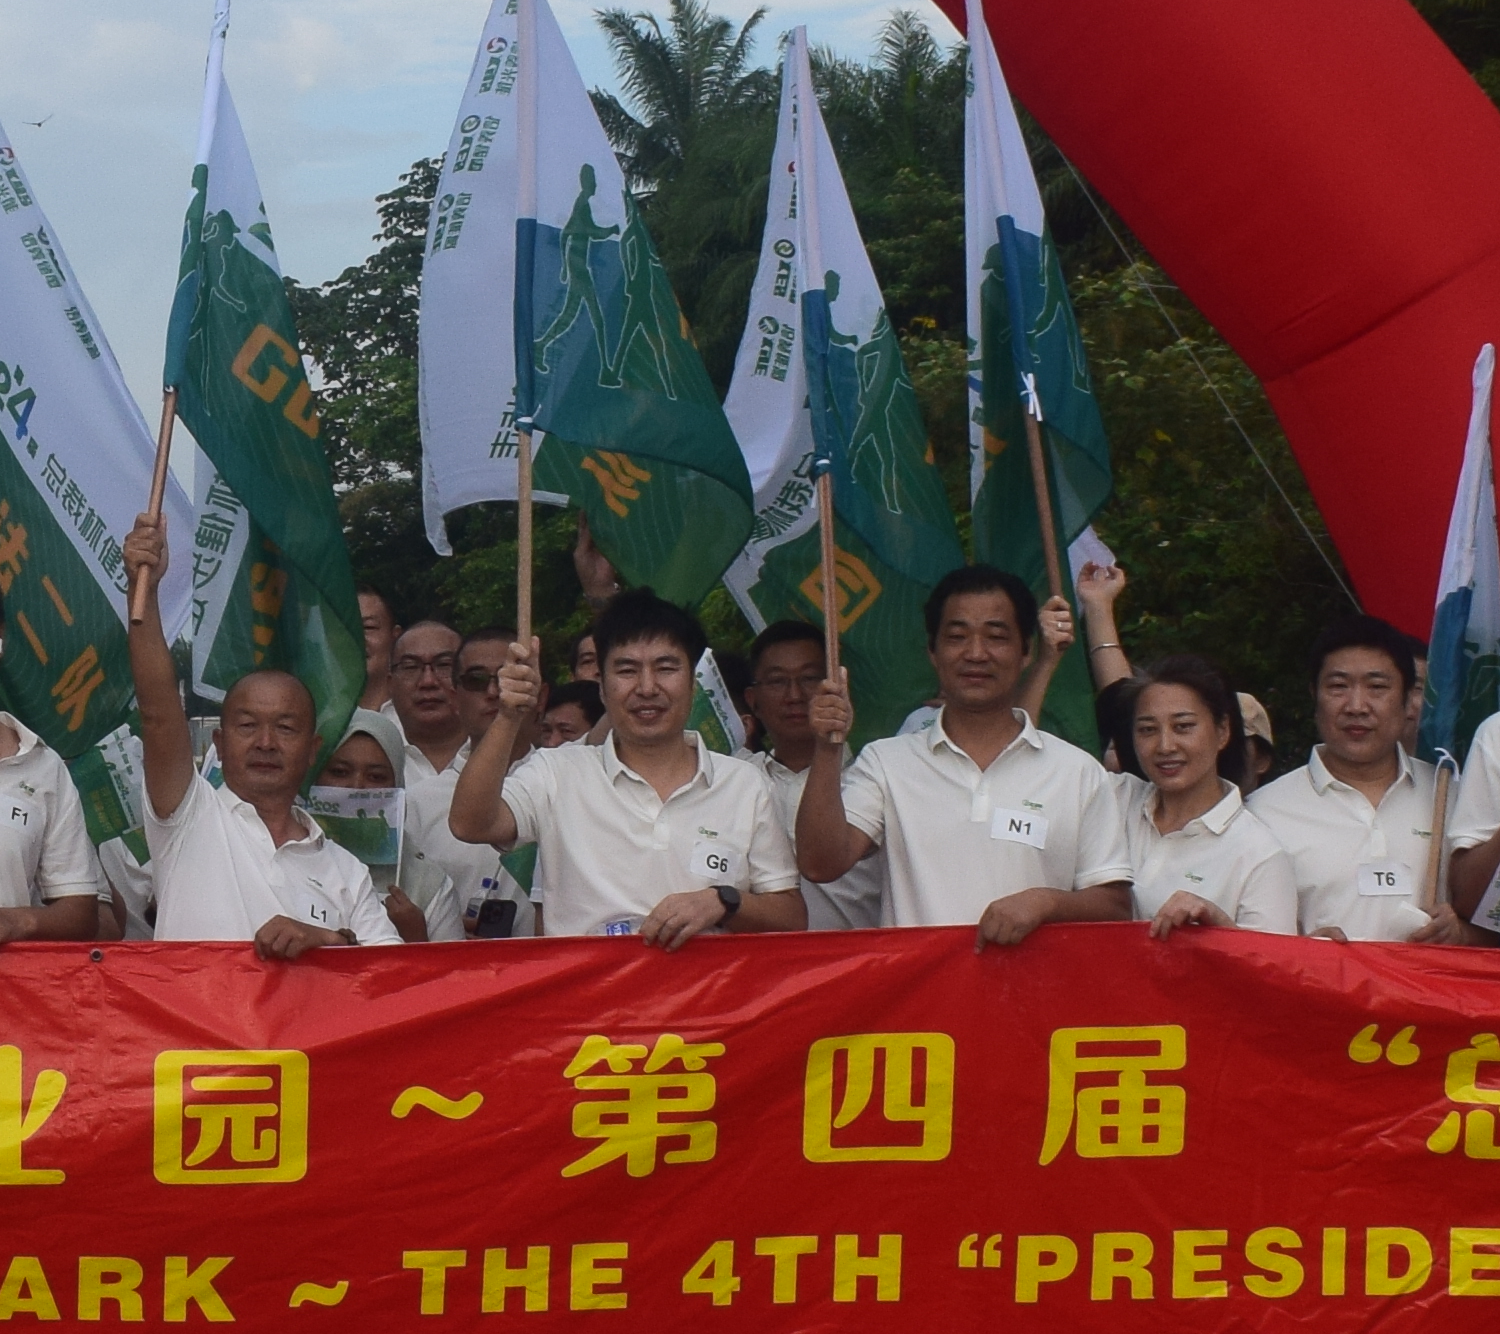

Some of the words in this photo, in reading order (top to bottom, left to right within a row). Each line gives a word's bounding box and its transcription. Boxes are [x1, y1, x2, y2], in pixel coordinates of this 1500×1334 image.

[10, 807, 29, 826] F1
[1008, 818, 1032, 836] N1
[705, 854, 728, 872] G6
[1373, 870, 1396, 886] T6
[309, 903, 328, 923] L1
[403, 1241, 630, 1316] THE
[681, 1233, 904, 1308] 4TH
